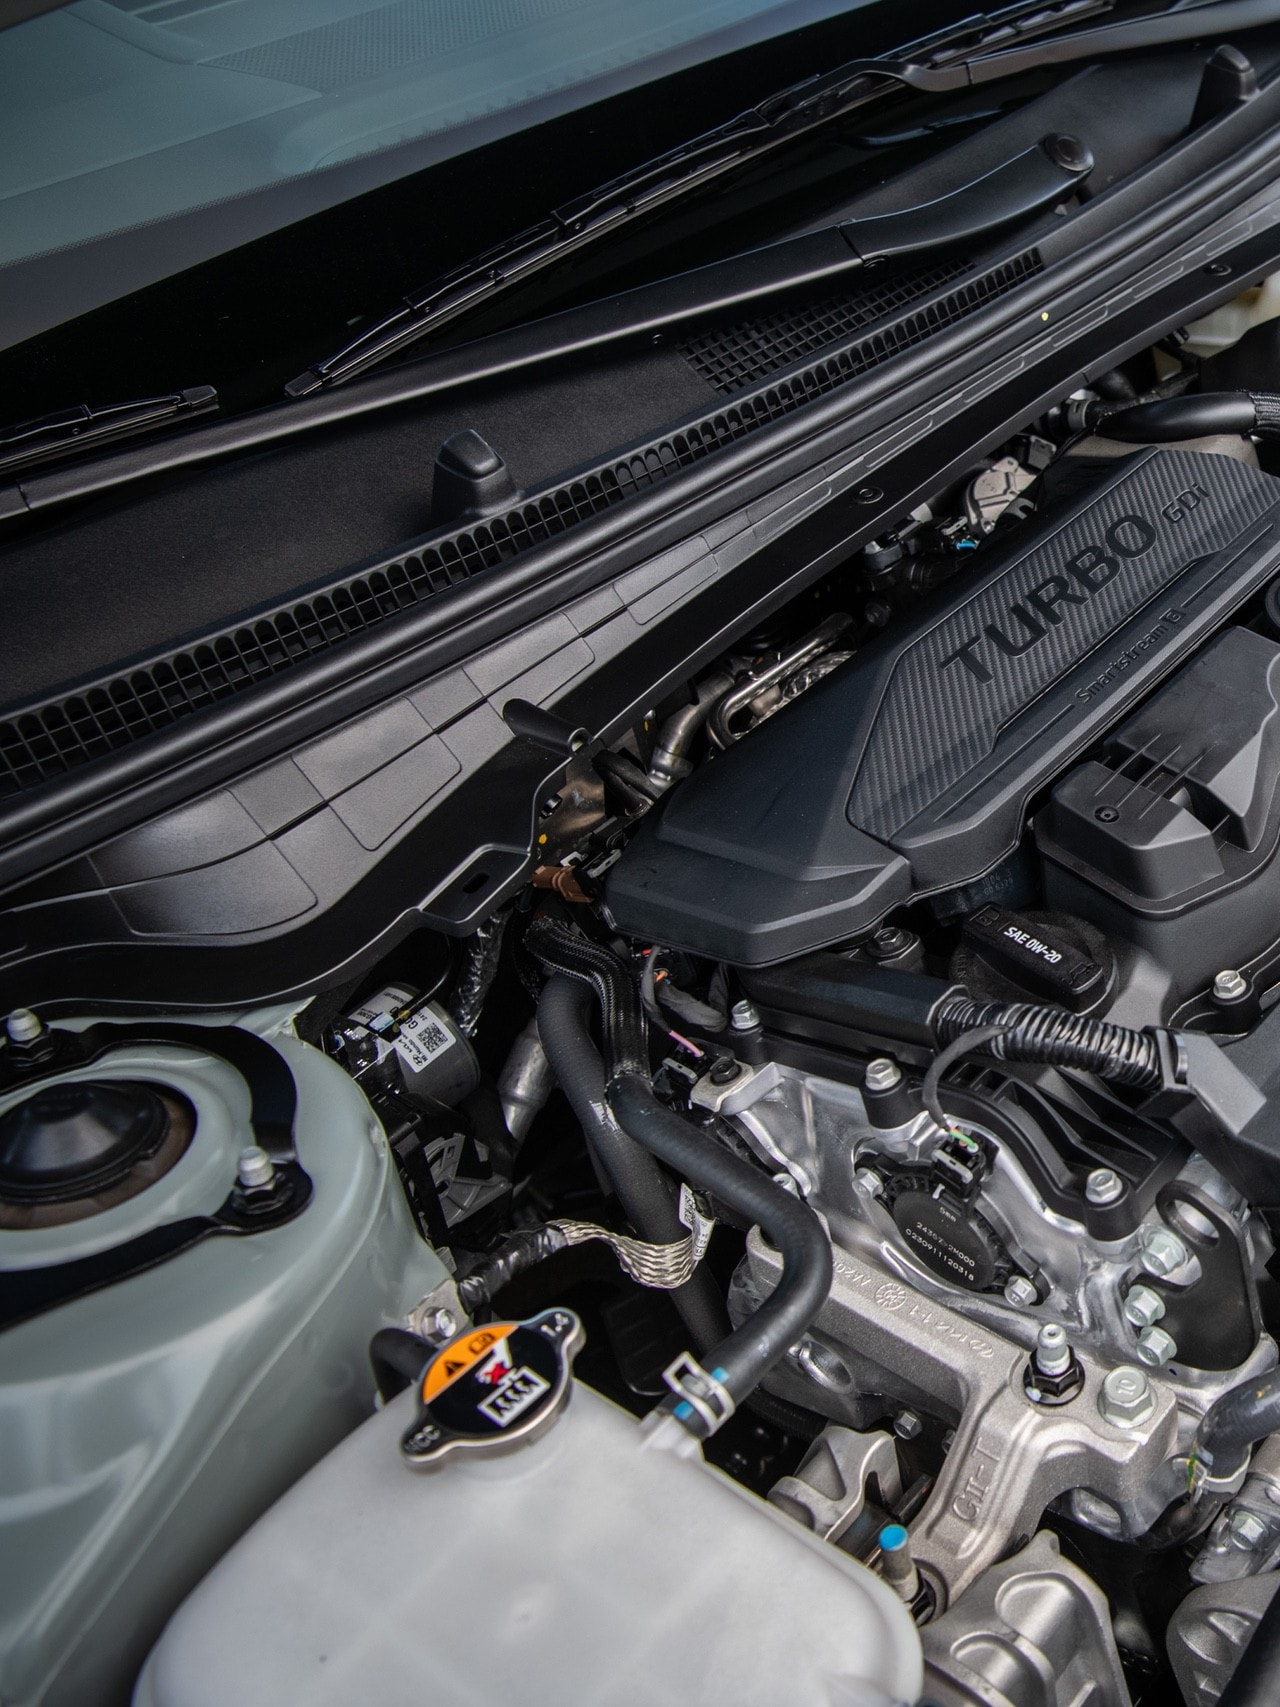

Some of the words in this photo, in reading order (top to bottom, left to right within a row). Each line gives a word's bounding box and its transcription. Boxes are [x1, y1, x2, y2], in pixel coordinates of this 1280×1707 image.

[939, 515, 1158, 684] TURBO
[1161, 483, 1209, 523] GDi
[1075, 624, 1168, 703] Smartstream
[1003, 926, 1030, 944] SAE
[1025, 939, 1062, 963] 0W-20
